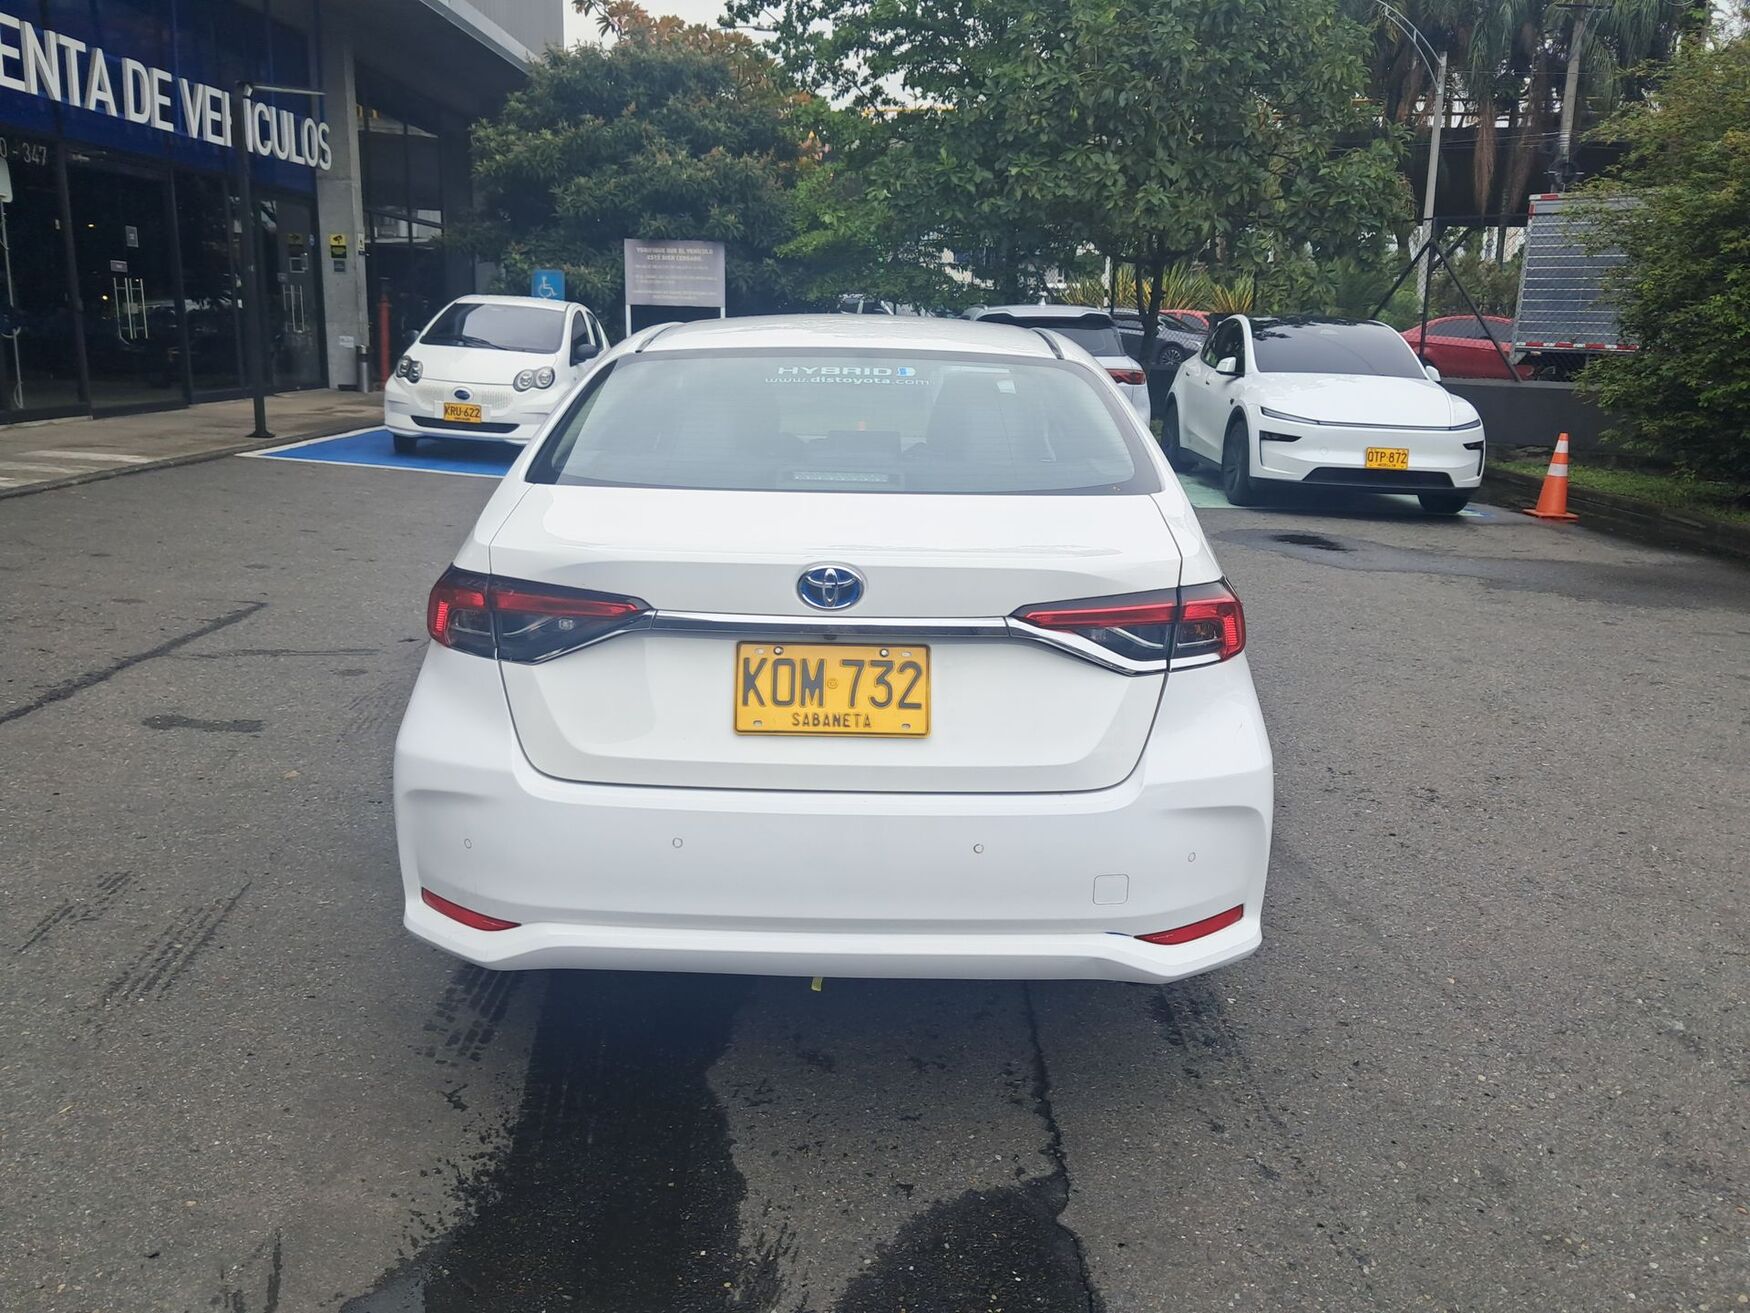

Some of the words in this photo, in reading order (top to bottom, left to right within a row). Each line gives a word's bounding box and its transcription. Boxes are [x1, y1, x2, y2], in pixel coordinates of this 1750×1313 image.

[122, 57, 175, 133] DE
[22, 142, 47, 166] 347
[765, 376, 930, 386] www.distoyota.com
[778, 367, 892, 376] HYBRID
[742, 657, 826, 708] KOM
[840, 659, 923, 709] 732
[792, 712, 873, 729] SABANETA
